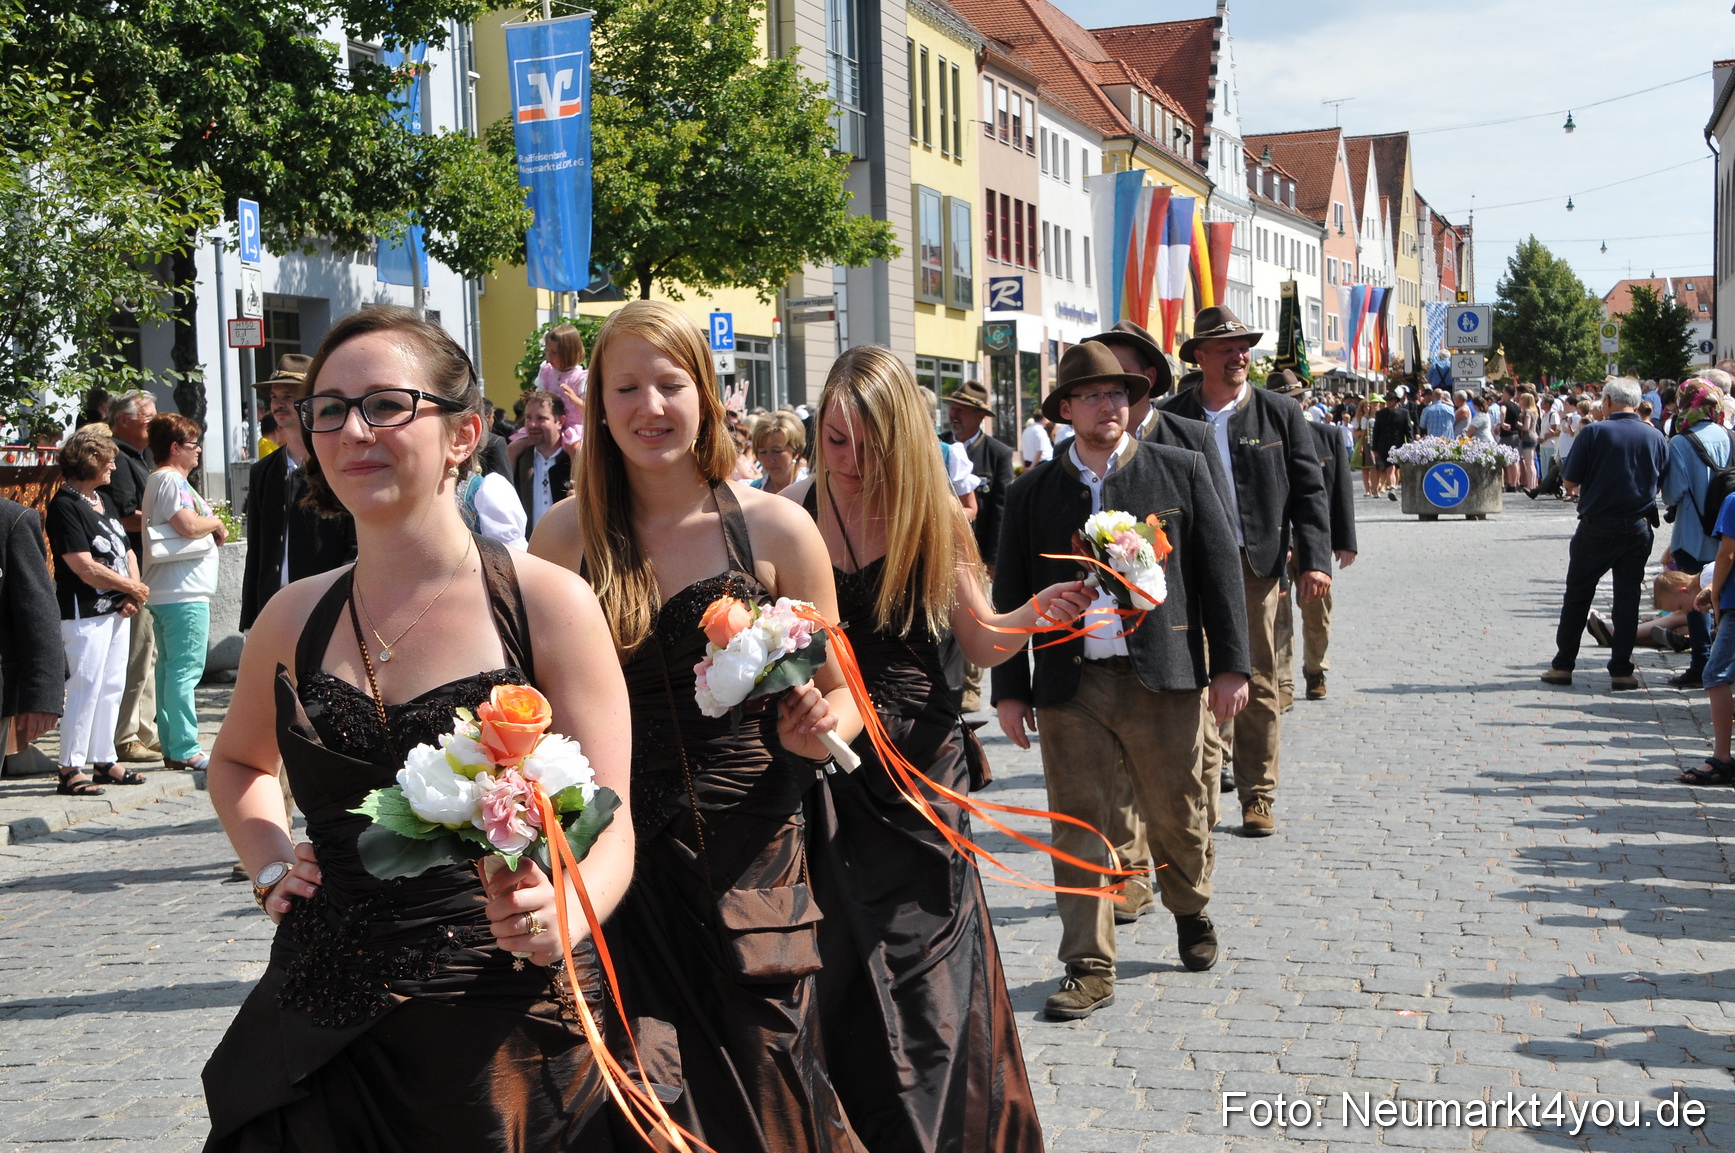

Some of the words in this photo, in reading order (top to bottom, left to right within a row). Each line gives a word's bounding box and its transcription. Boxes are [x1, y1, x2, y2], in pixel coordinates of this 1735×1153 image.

[519, 150, 567, 163] Raiffeisenbank
[520, 163, 555, 174] Neumarkt
[574, 158, 584, 166] eG
[243, 208, 256, 255] P
[1457, 292, 1468, 302] H
[714, 316, 729, 346] P
